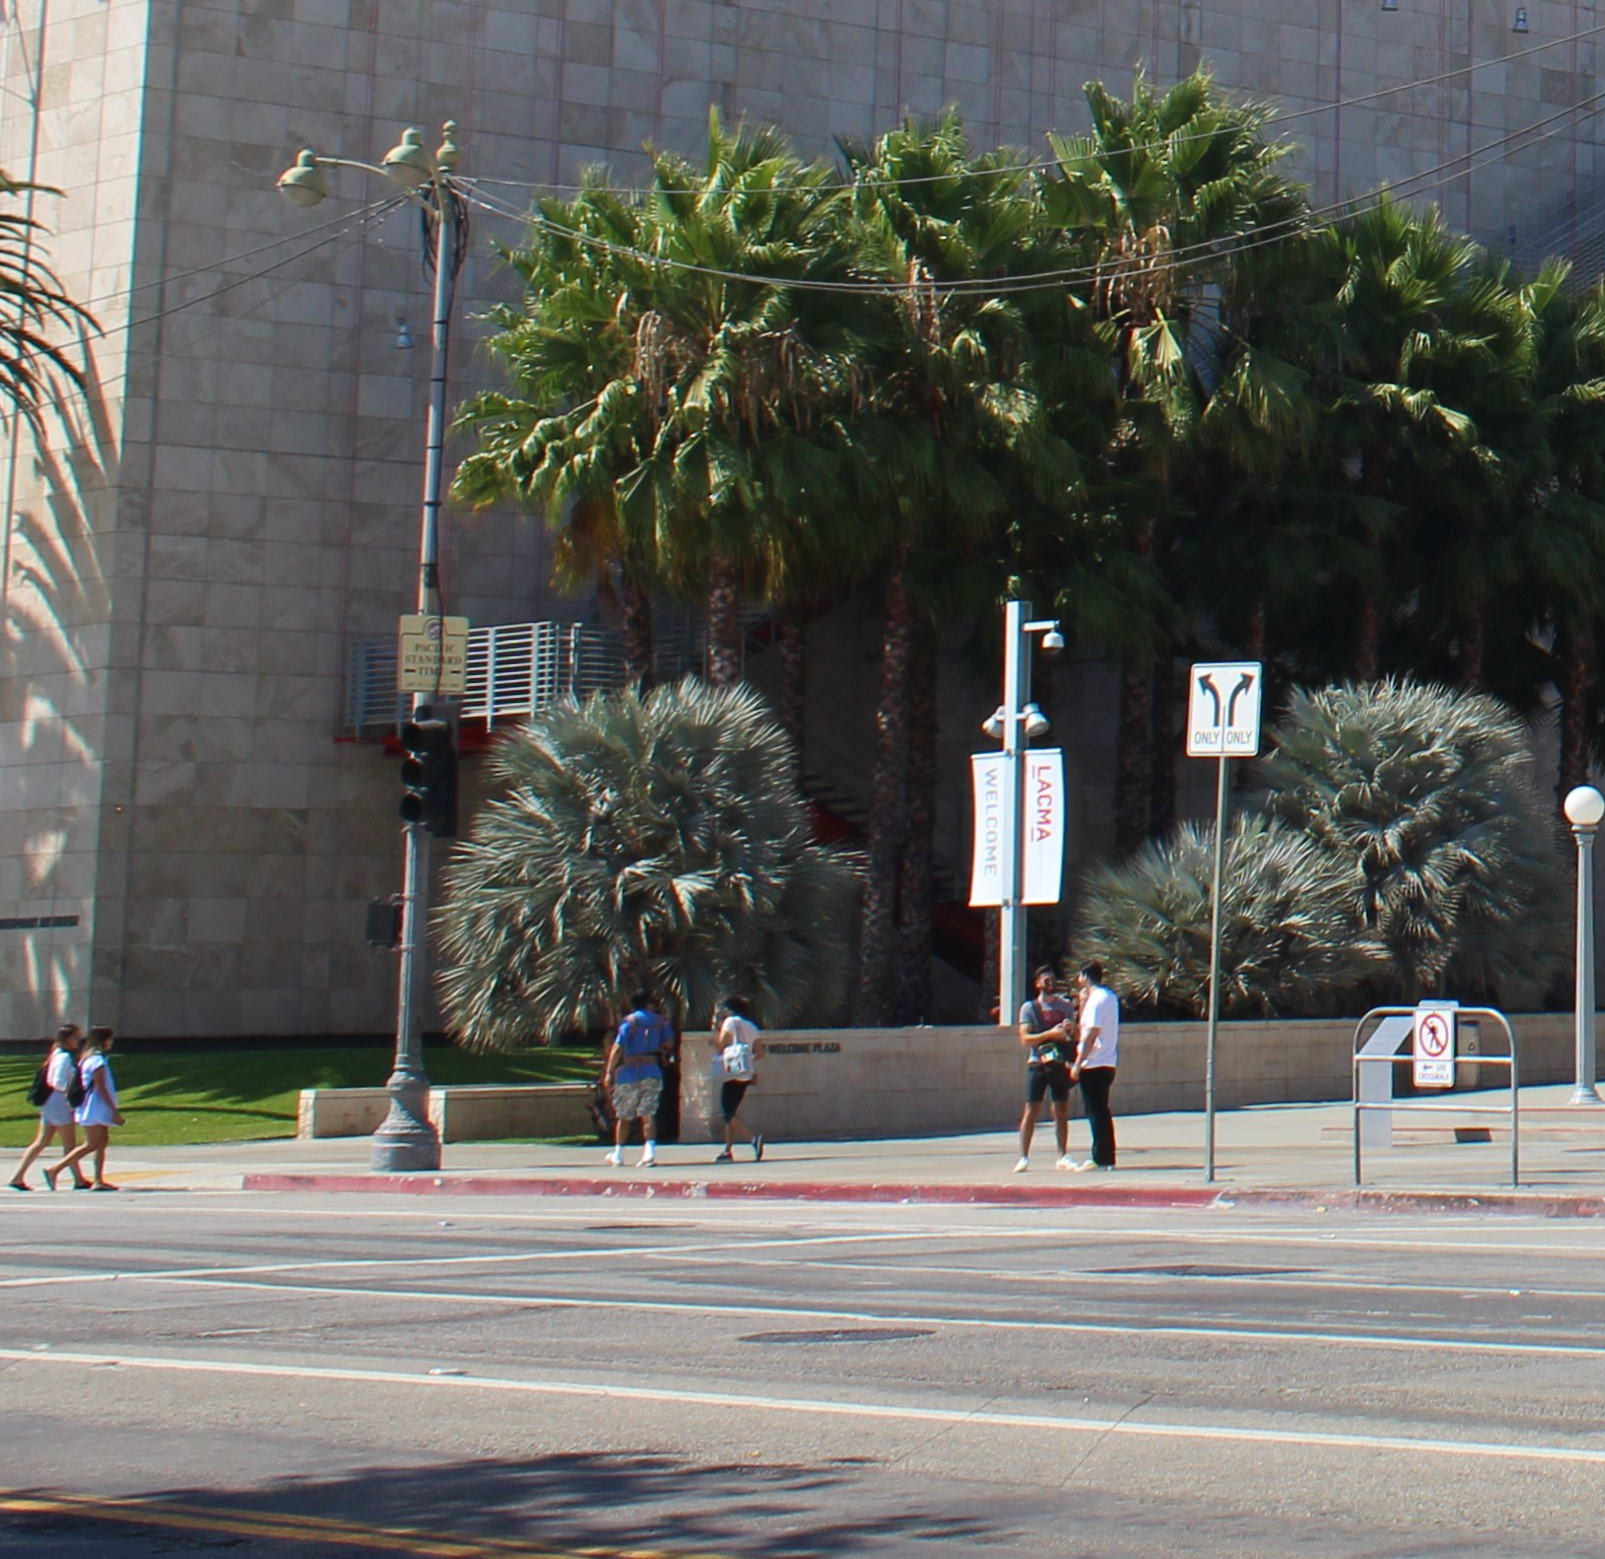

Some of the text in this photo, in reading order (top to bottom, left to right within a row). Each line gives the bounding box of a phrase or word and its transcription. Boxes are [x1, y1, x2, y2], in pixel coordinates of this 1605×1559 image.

[415, 643, 456, 653] PACIIC
[1194, 730, 1253, 745] ONLY ONLY
[983, 767, 999, 877] WELCOME
[1035, 765, 1053, 842] LACMA
